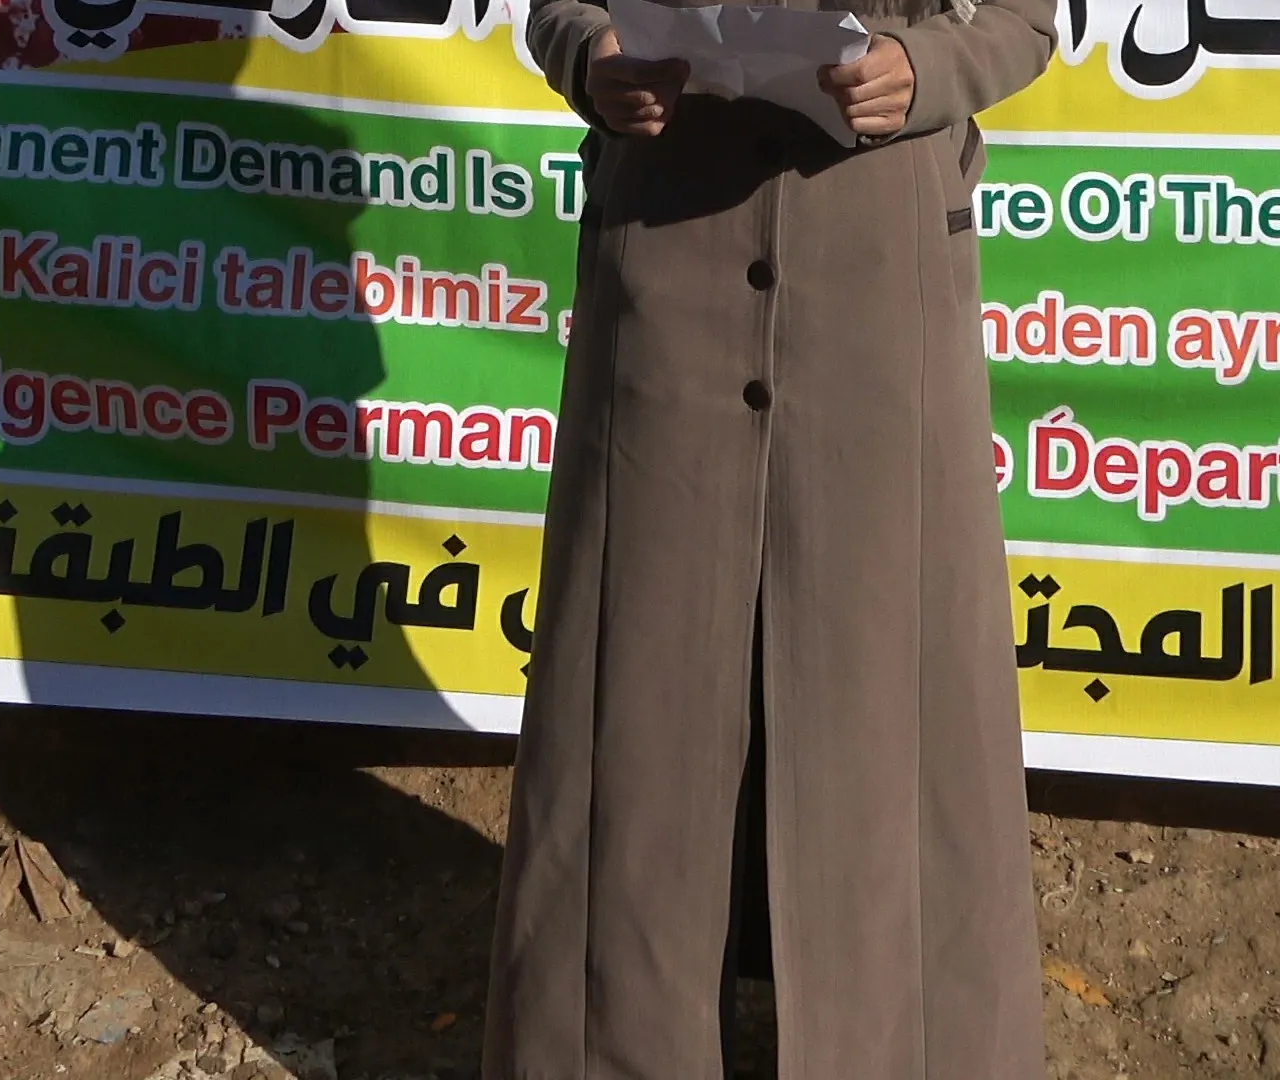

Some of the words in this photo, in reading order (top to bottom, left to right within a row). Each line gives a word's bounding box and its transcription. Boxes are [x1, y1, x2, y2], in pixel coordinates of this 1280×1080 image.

[181, 128, 449, 205] Demand
[471, 155, 528, 213] Is
[1069, 178, 1149, 236] Of
[1, 234, 199, 304] Kalici
[221, 252, 544, 327] talebimiz
[251, 384, 554, 464] Perman
[308, 532, 482, 671] في
[1016, 573, 1274, 702] المجت
